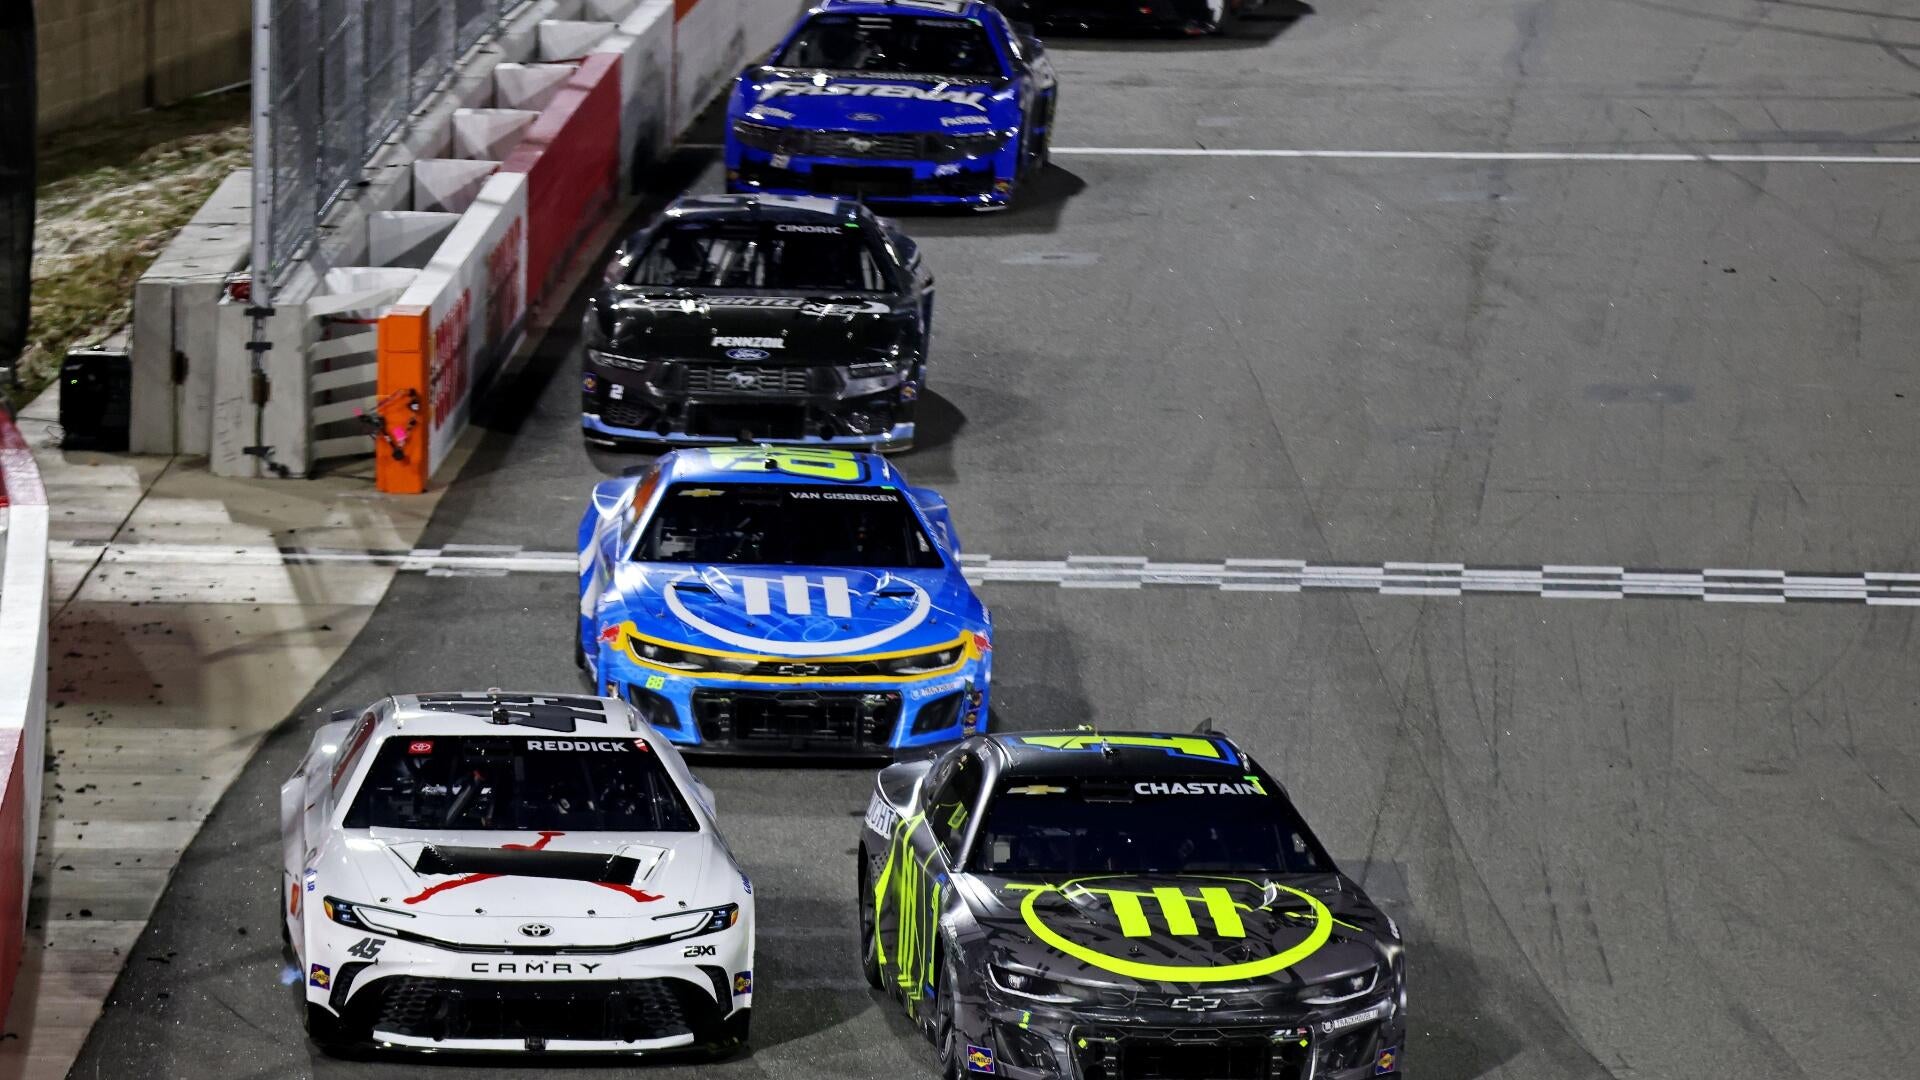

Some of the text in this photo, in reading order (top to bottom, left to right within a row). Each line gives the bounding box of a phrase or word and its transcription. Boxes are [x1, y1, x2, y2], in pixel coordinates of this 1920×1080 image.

[758, 81, 987, 112] FASTENAL
[776, 224, 842, 235] CINDRIC
[711, 336, 786, 349] PENNZOIL
[609, 384, 624, 400] 2
[790, 491, 898, 503] VAN GISBERGEN
[646, 675, 665, 690] 88
[527, 739, 629, 753] REDDICK
[1134, 781, 1258, 796] CHASTAIN
[347, 937, 386, 958] 45
[471, 962, 602, 975] CAMRY
[969, 1054, 992, 1064] SUNOCO
